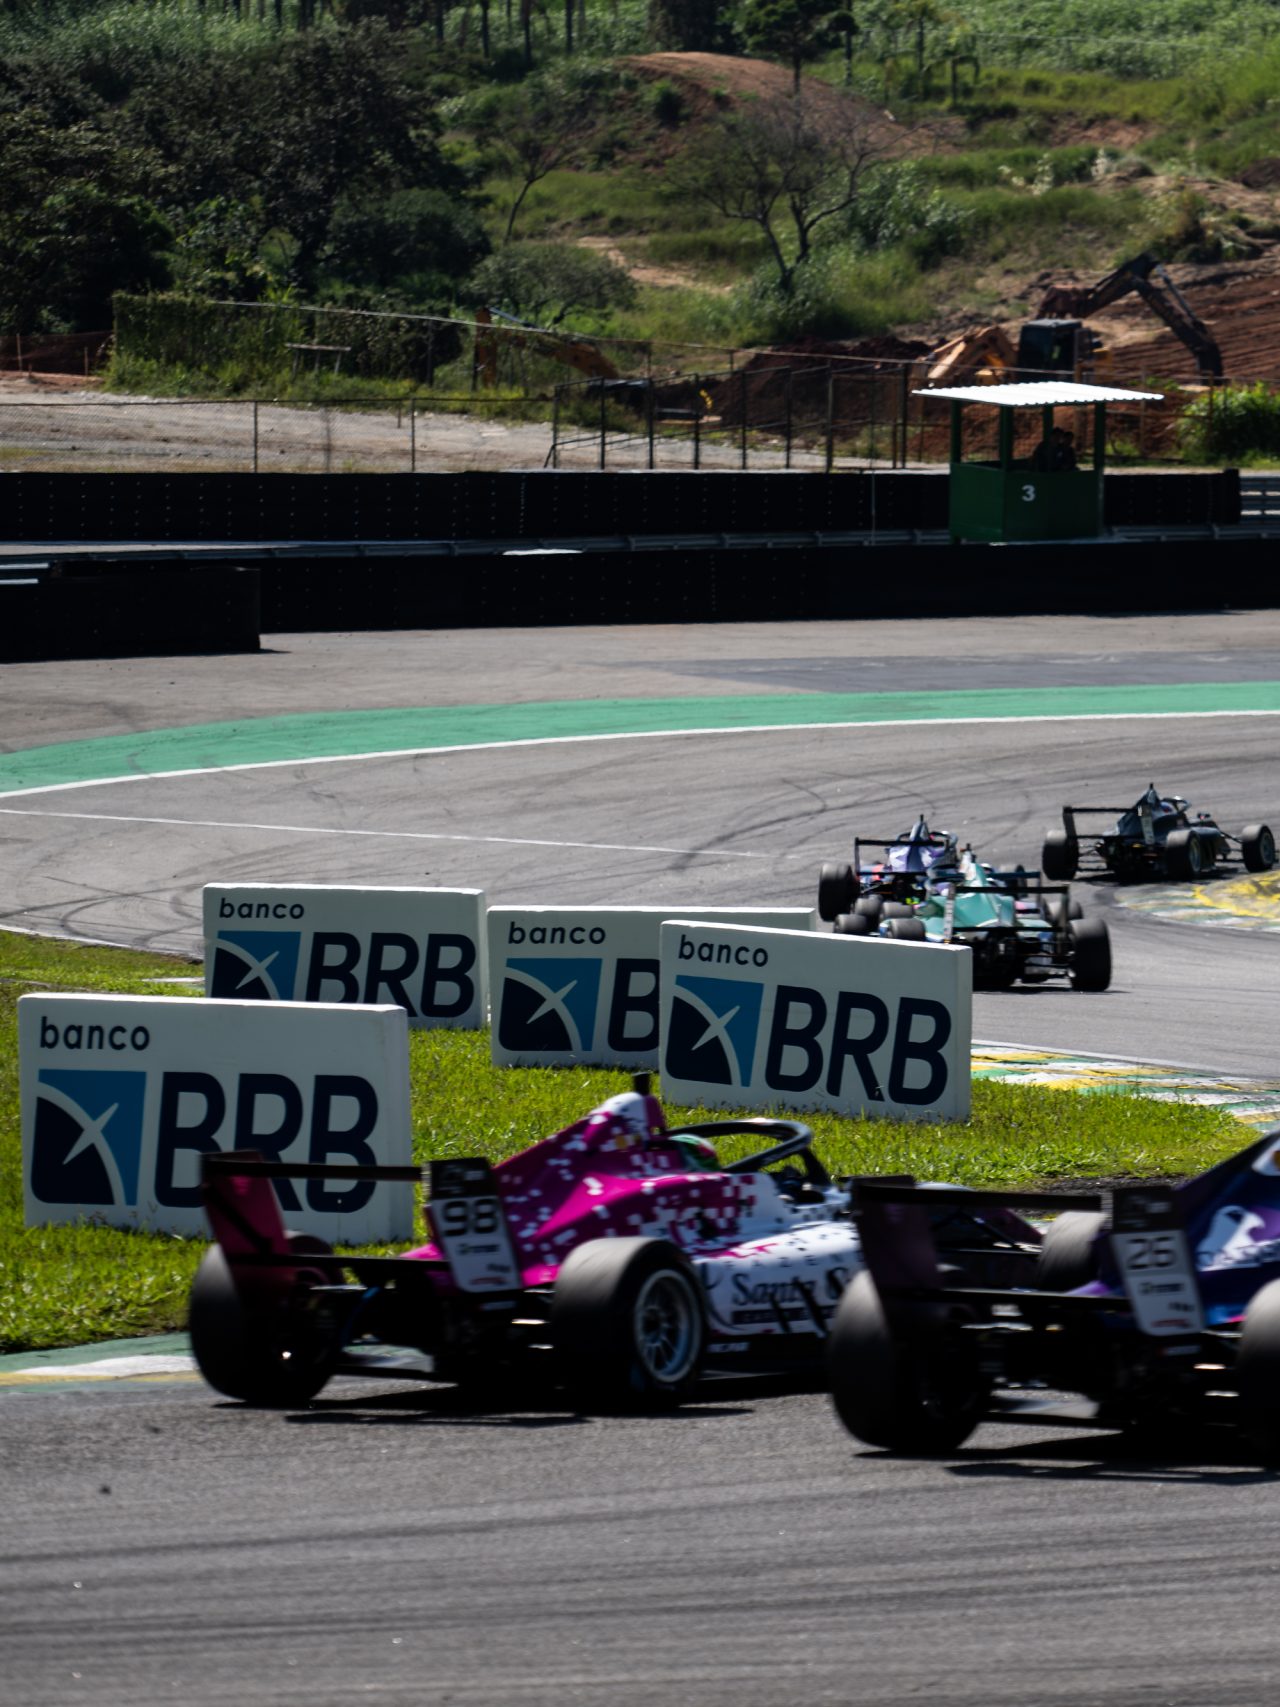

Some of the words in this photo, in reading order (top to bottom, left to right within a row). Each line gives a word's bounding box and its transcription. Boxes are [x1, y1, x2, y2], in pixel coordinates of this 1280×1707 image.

[1021, 484, 1036, 502] 3
[218, 897, 305, 920] banco
[507, 921, 606, 945] banco
[678, 934, 769, 968] banco
[306, 931, 477, 1019] BRB
[40, 1016, 151, 1051] banco
[765, 984, 951, 1106] BRB
[154, 1071, 379, 1214] BRB
[441, 1199, 498, 1237] 98
